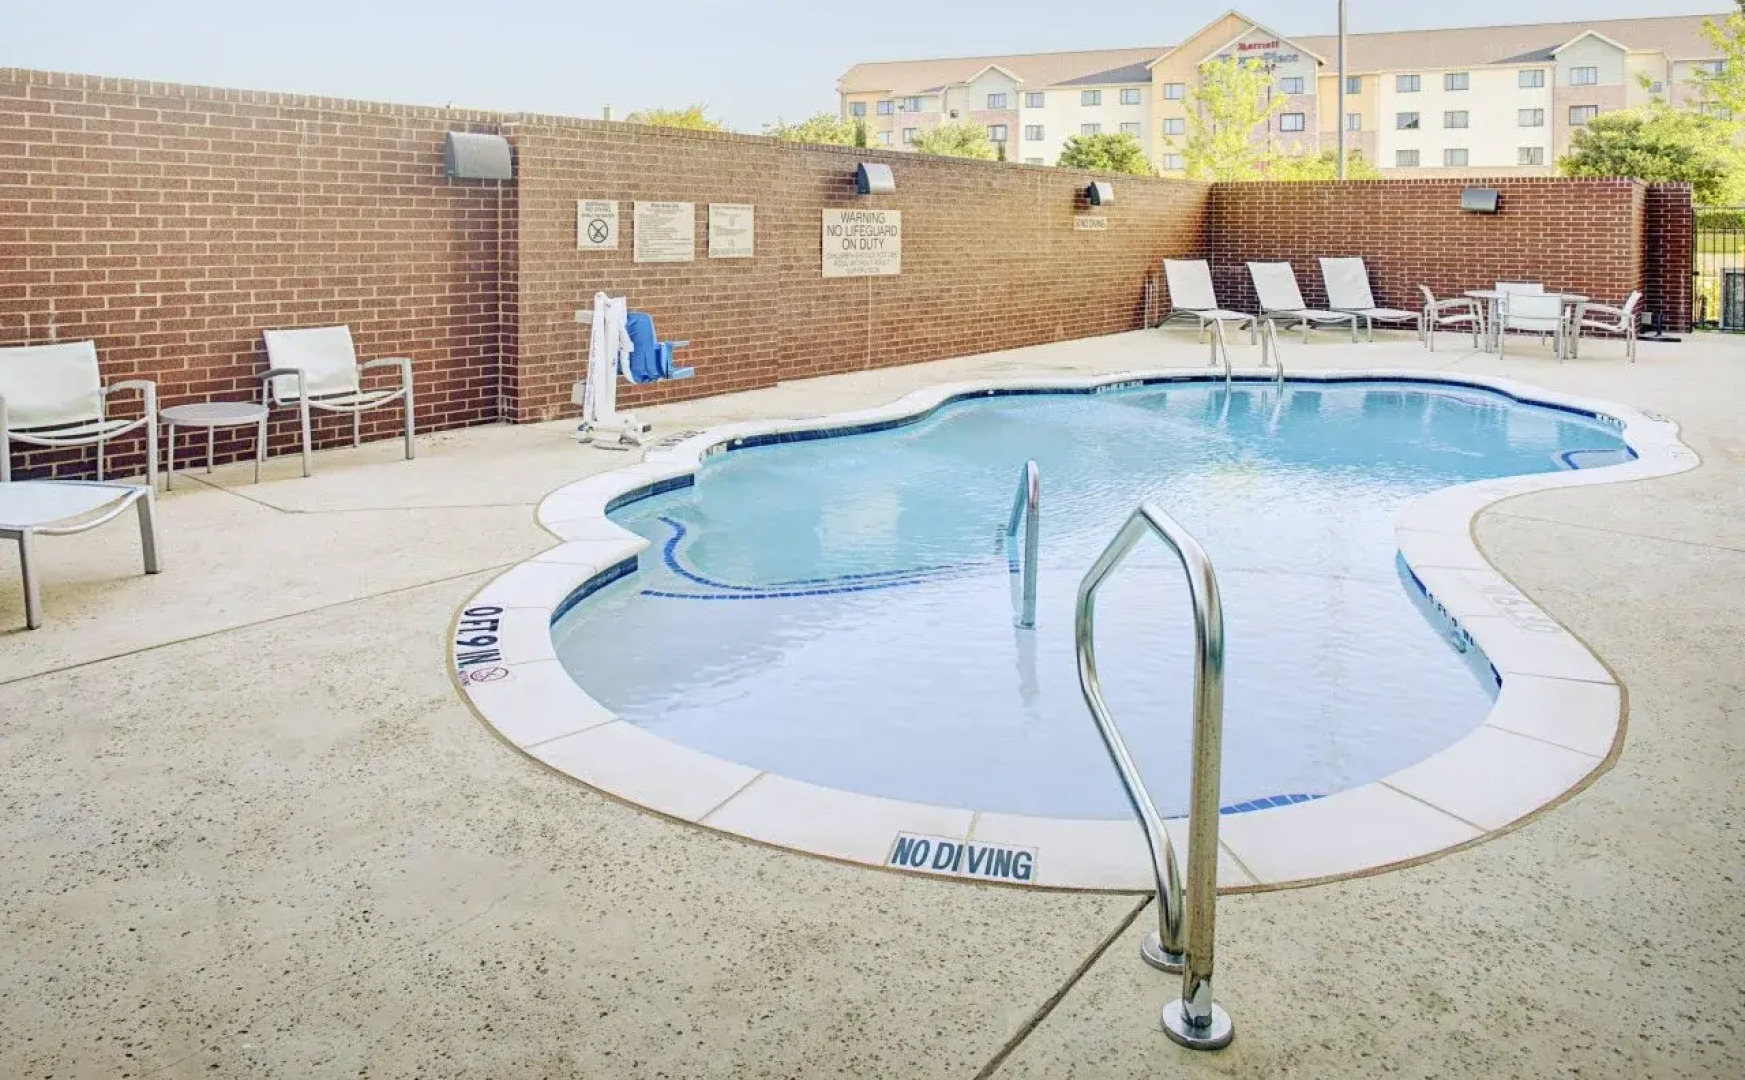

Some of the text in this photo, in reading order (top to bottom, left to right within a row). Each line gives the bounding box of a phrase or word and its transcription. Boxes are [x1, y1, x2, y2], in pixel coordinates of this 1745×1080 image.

[1238, 41, 1279, 51] Marriott
[841, 212, 885, 224] WARNING
[826, 224, 897, 237] NO LIFEGUARD
[842, 238, 885, 250] ON DUTY
[891, 837, 1033, 880] NO DIVING
